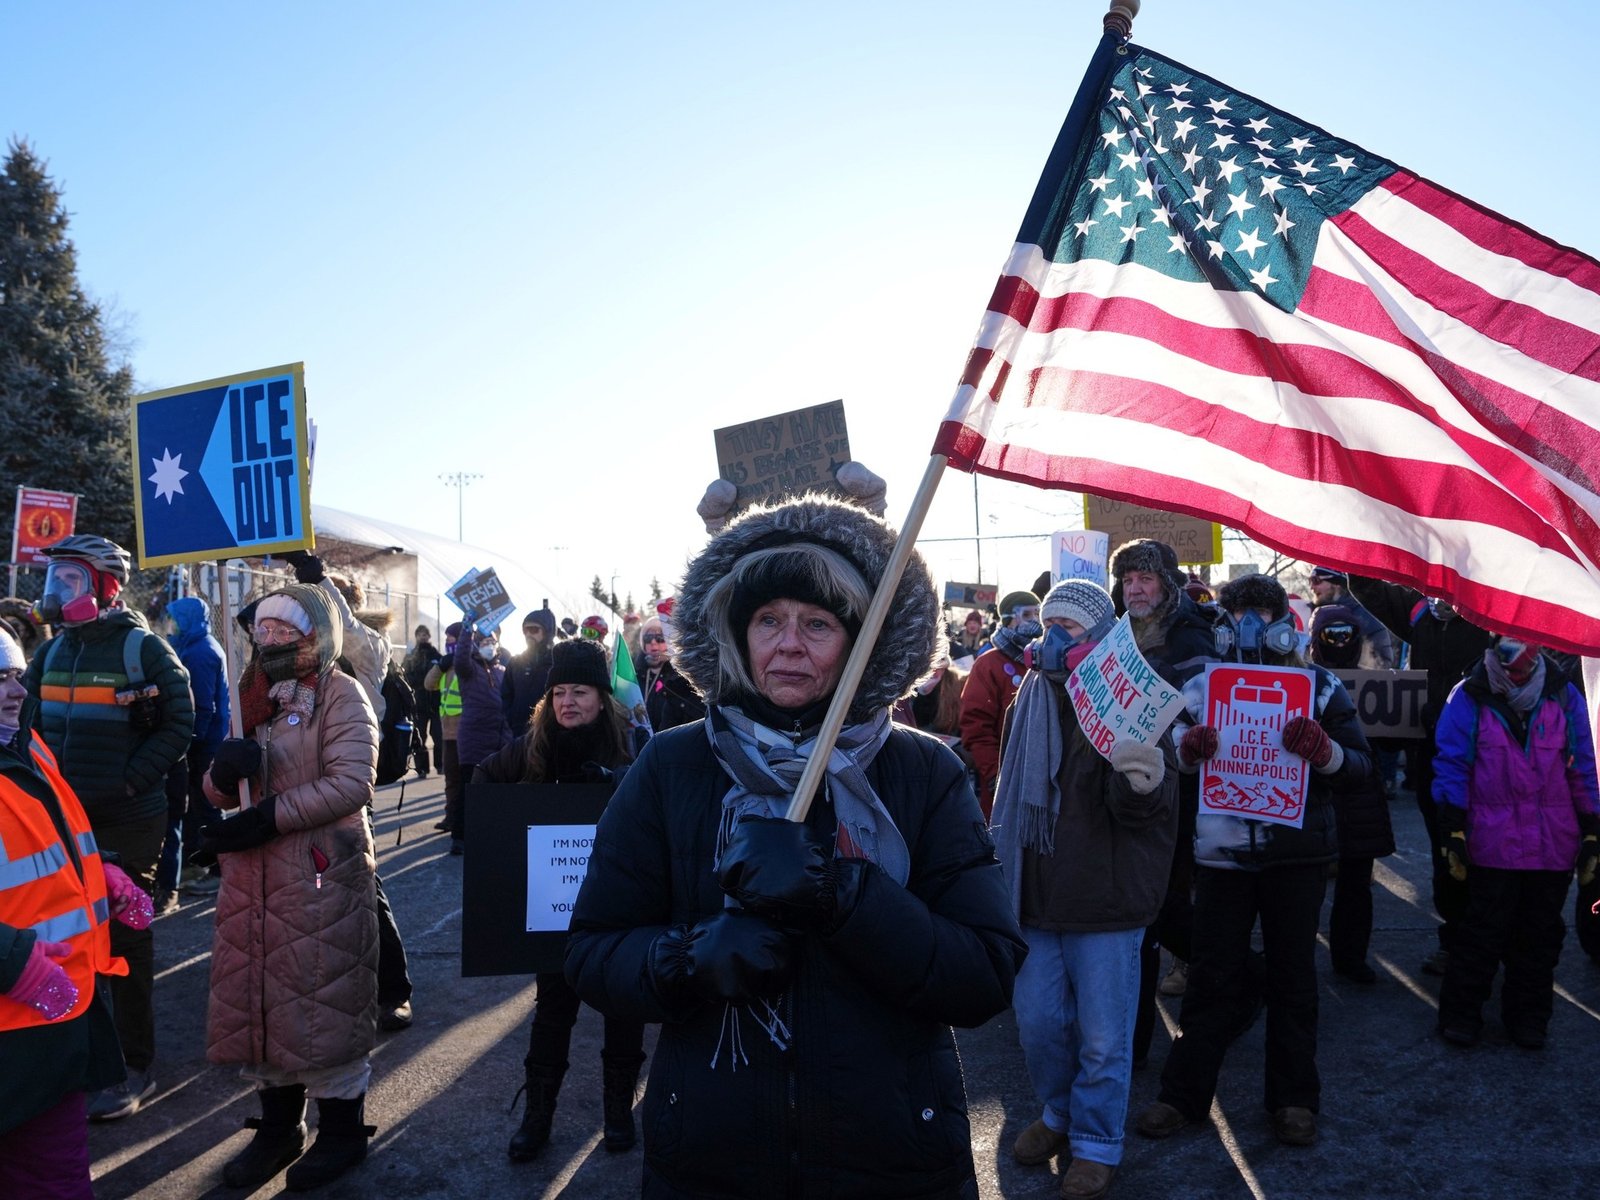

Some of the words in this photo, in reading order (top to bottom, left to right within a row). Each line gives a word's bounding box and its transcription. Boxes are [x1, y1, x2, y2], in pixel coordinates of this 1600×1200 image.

[229, 379, 292, 464] ICE
[724, 417, 785, 457] THEY
[788, 404, 846, 445] HATE
[719, 462, 748, 485] US
[753, 439, 826, 478] BECAUSE
[824, 438, 850, 455] WE
[233, 458, 294, 542] OUT
[1123, 513, 1176, 533] OPPRESS
[1060, 535, 1086, 554] NO
[1073, 558, 1102, 577] ONLY
[460, 575, 504, 611] RESIST
[1100, 651, 1142, 710] HEART
[1119, 642, 1160, 697] SHAPE
[1160, 690, 1178, 708] of
[1079, 655, 1115, 719] SHADOW
[1115, 714, 1127, 729] of
[1358, 679, 1428, 727] OUT
[1137, 713, 1156, 733] the
[1240, 729, 1272, 746] I.C.E.
[1231, 745, 1257, 760] OUT
[1262, 747, 1280, 762] OF
[1211, 759, 1298, 782] MINNEAPOLIS
[553, 839, 569, 848] I'M
[551, 857, 567, 866] I'M
[562, 875, 579, 884] I'M
